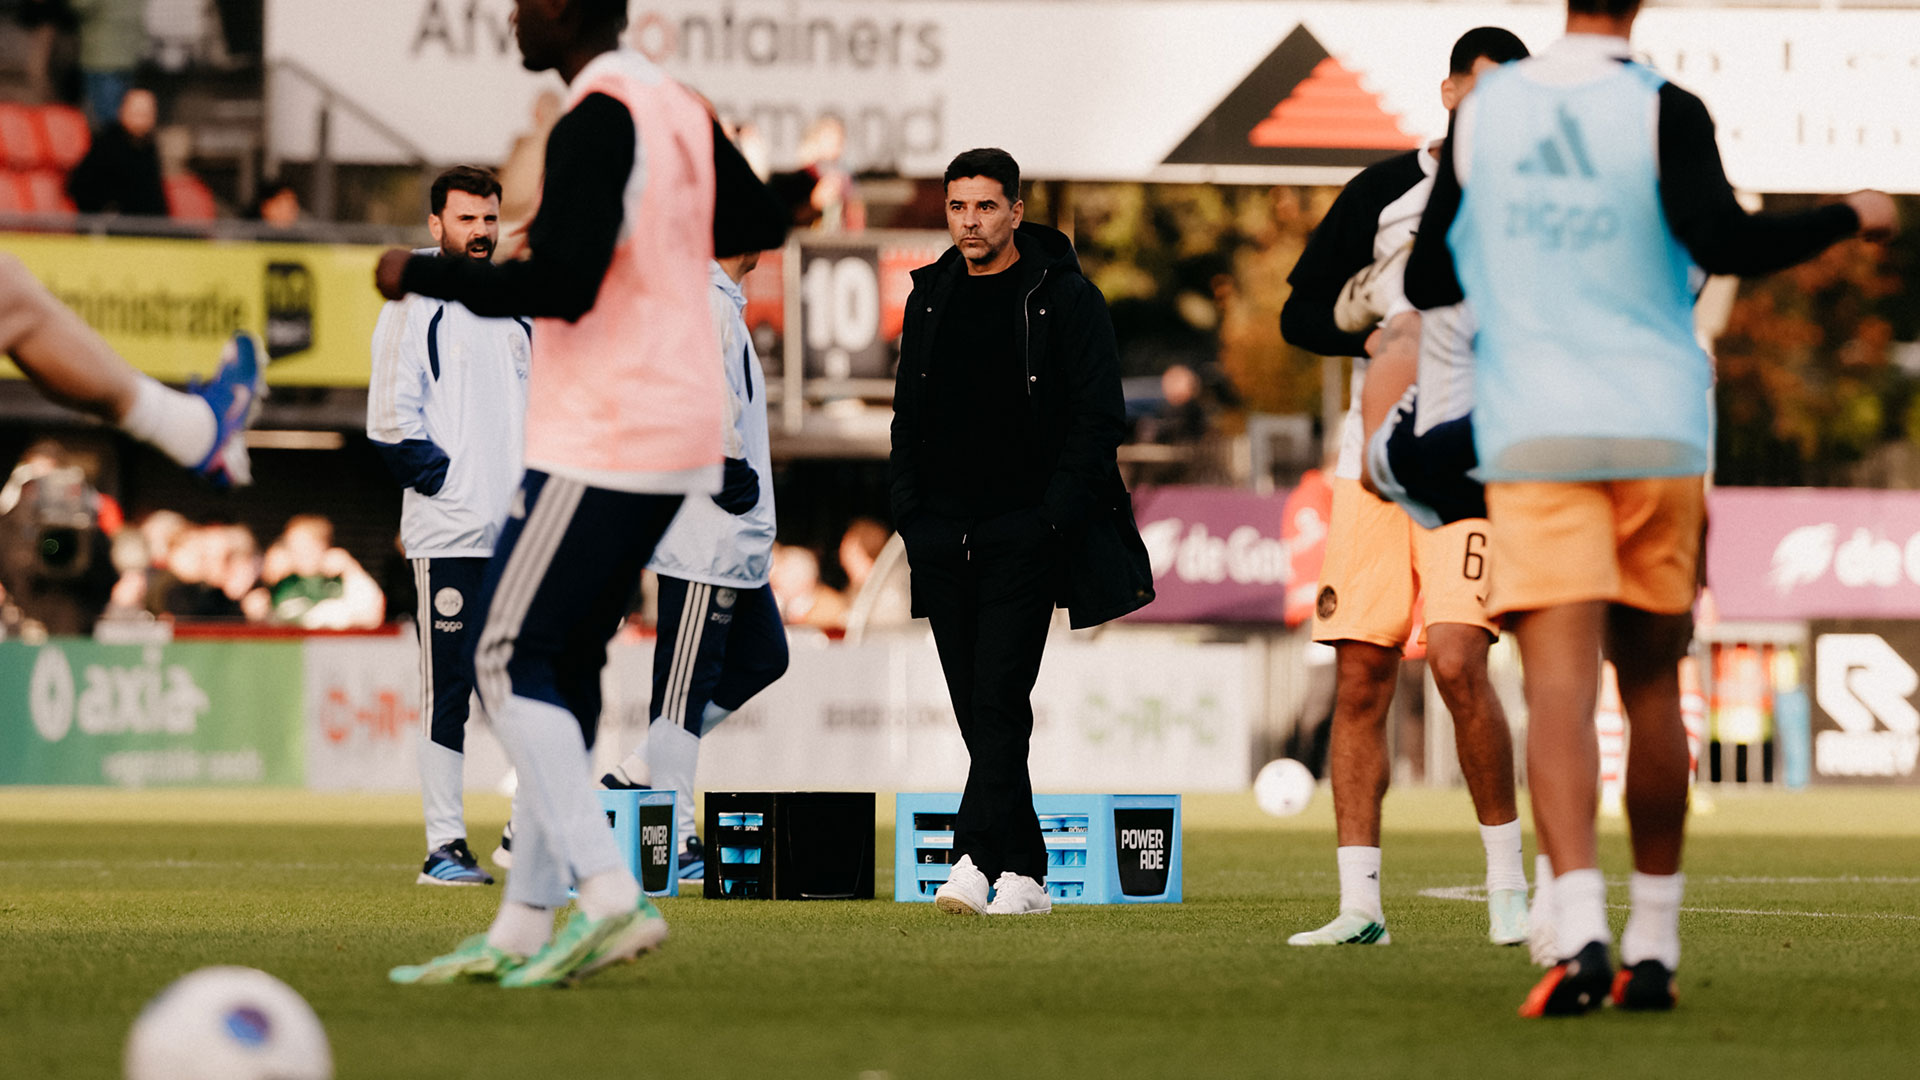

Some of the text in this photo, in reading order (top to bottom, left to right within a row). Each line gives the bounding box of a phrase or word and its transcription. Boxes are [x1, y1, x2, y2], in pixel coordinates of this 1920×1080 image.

[803, 257, 880, 353] 10
[1464, 532, 1486, 581] 6
[434, 619, 463, 632] ziggo
[642, 825, 668, 846] POWER
[1121, 829, 1164, 849] POWER
[652, 845, 668, 865] ADE
[1140, 849, 1164, 870] ADE
